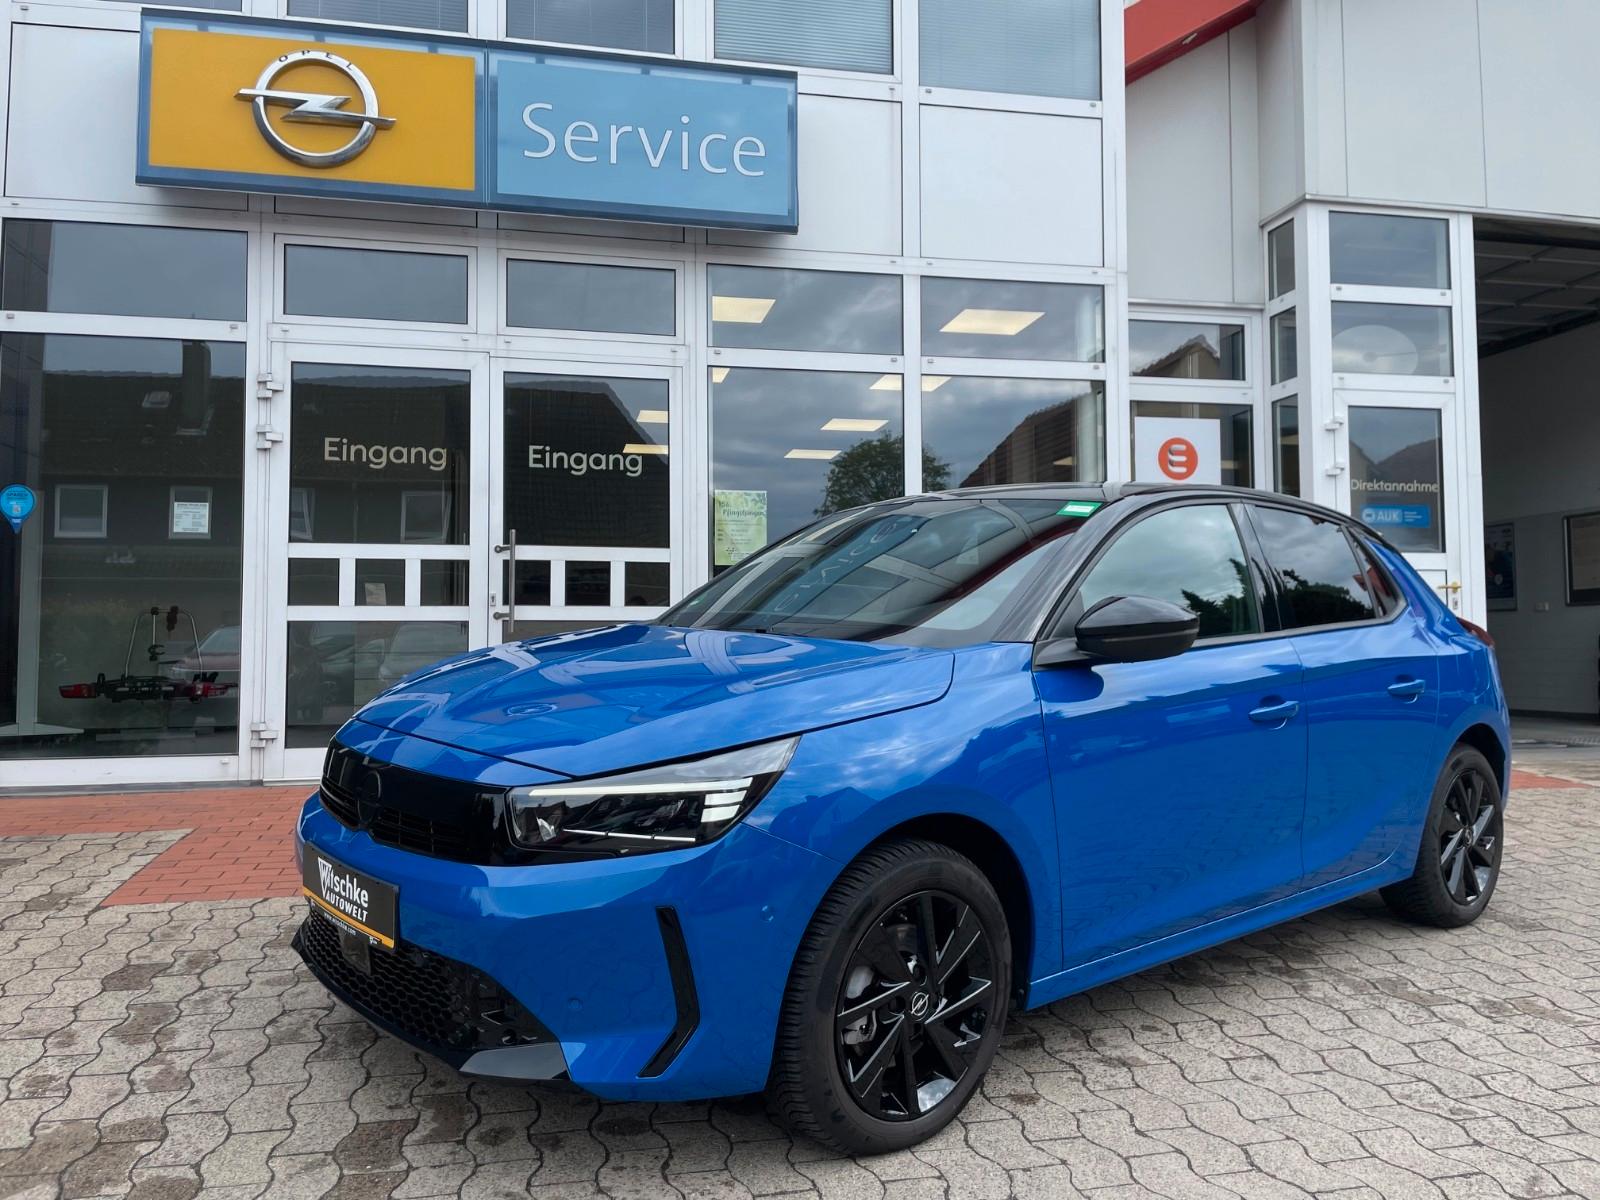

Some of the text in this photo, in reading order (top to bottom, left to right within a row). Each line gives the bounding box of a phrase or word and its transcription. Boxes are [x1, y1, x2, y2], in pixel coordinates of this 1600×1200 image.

[279, 49, 353, 71] OPEL
[522, 102, 766, 177] Service
[323, 436, 448, 472] Eingang
[528, 444, 644, 476] Eingang
[1350, 478, 1440, 493] Direktannahme
[318, 857, 369, 908] Witschke
[325, 890, 369, 922] AUTOWELT
